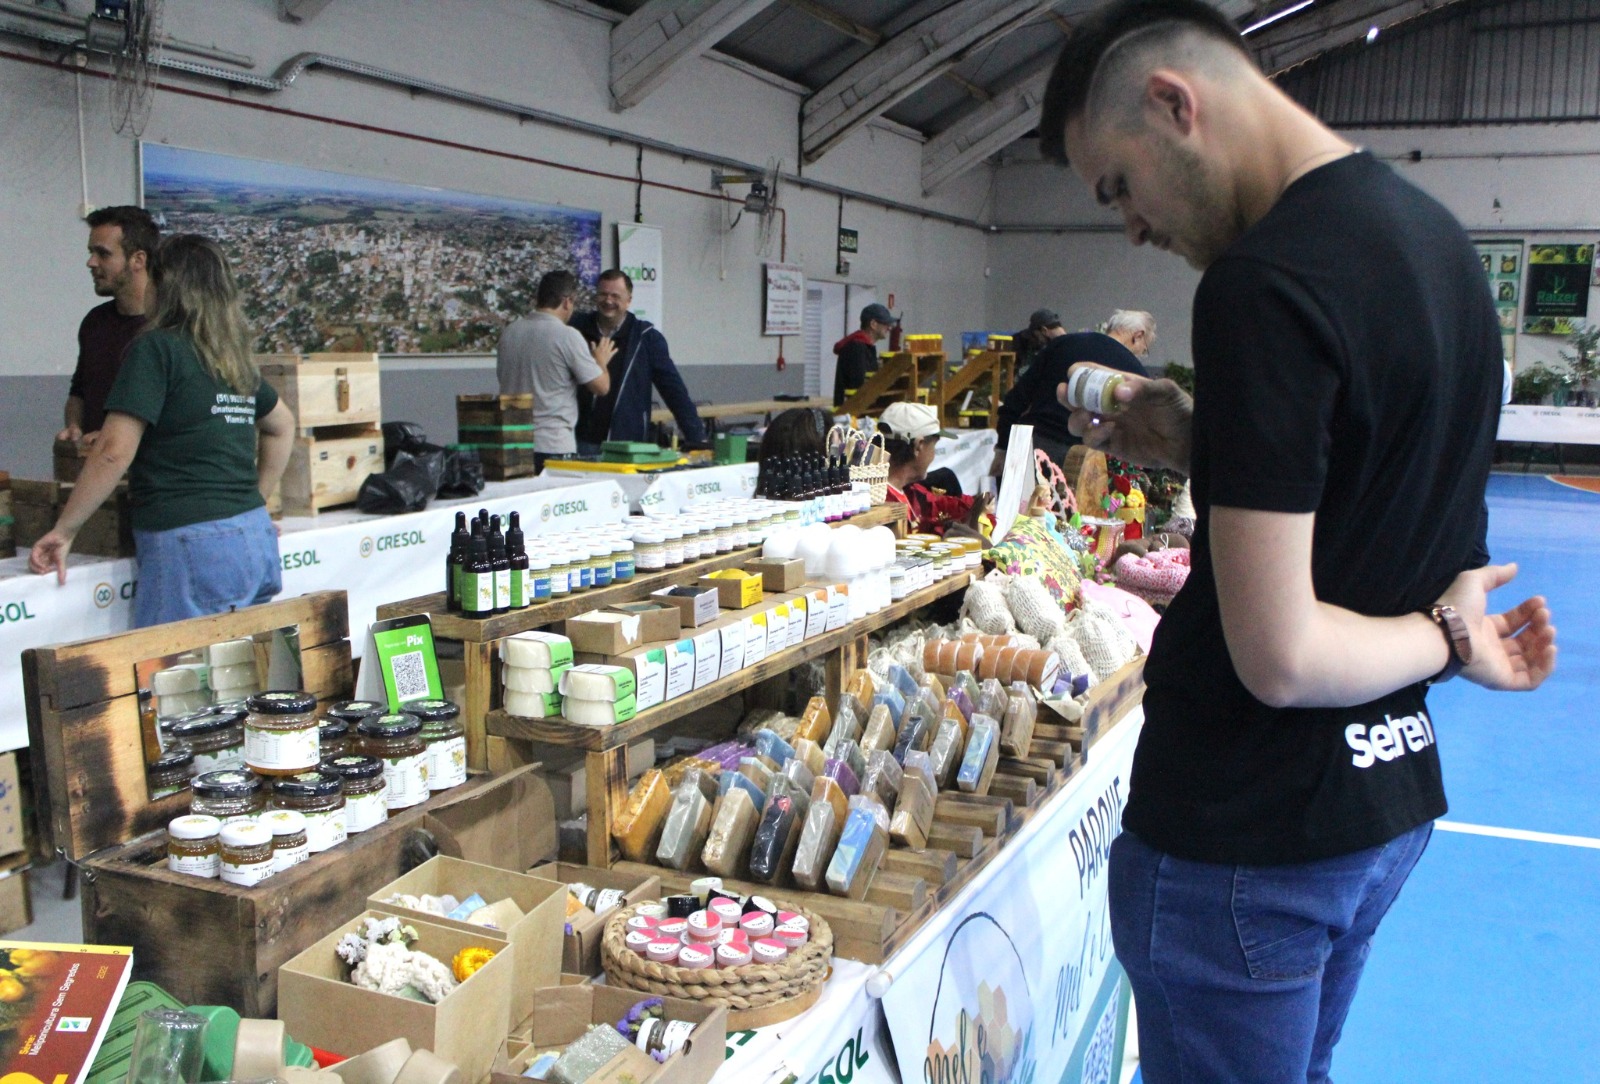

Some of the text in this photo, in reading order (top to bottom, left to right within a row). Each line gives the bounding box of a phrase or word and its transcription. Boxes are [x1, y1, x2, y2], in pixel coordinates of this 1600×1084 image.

[695, 482, 721, 494] CRESOL
[553, 500, 588, 516] CRESOL
[376, 531, 426, 552] CRESOL
[406, 635, 423, 647] Pix
[52, 992, 67, 1007] Sem
[808, 1026, 869, 1084] SOL
